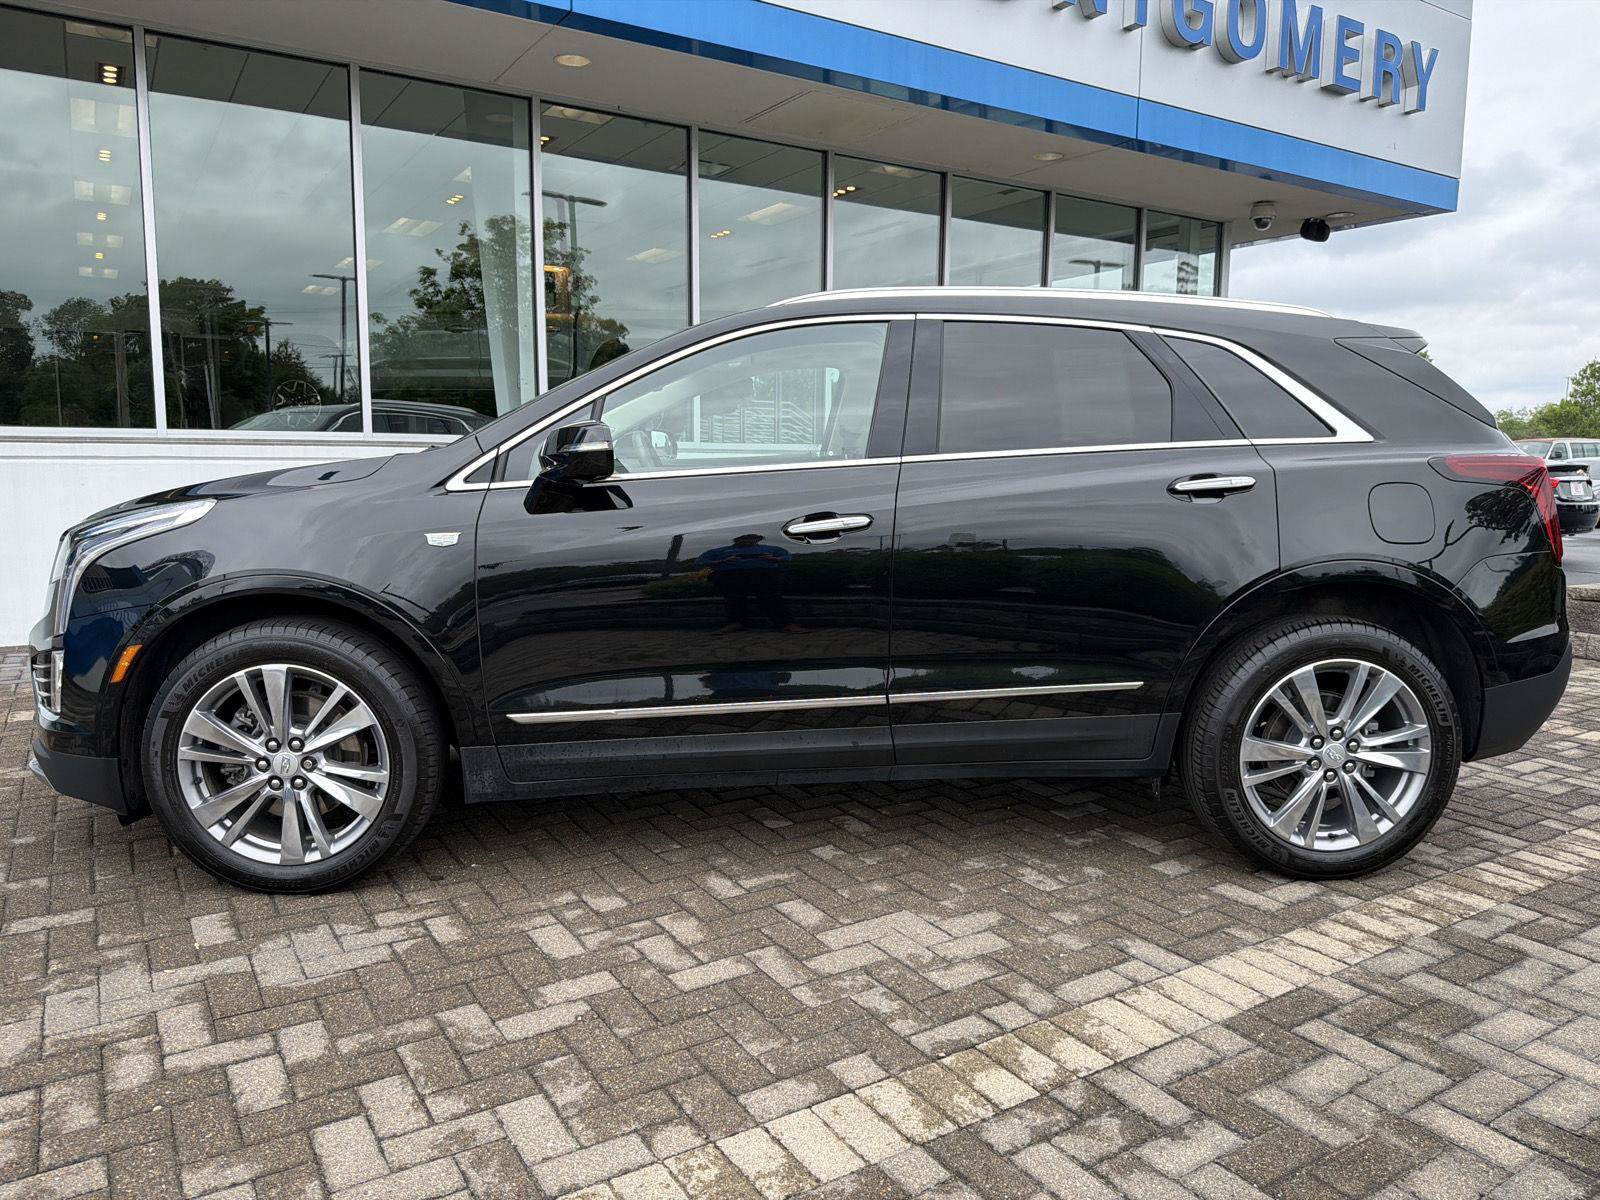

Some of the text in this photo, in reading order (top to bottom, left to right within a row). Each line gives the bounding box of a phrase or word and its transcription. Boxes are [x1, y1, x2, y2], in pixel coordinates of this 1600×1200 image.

[1051, 0, 1439, 115] GOMERY
[1407, 663, 1450, 724] MICHELIN
[1225, 791, 1269, 849] MICHELIN
